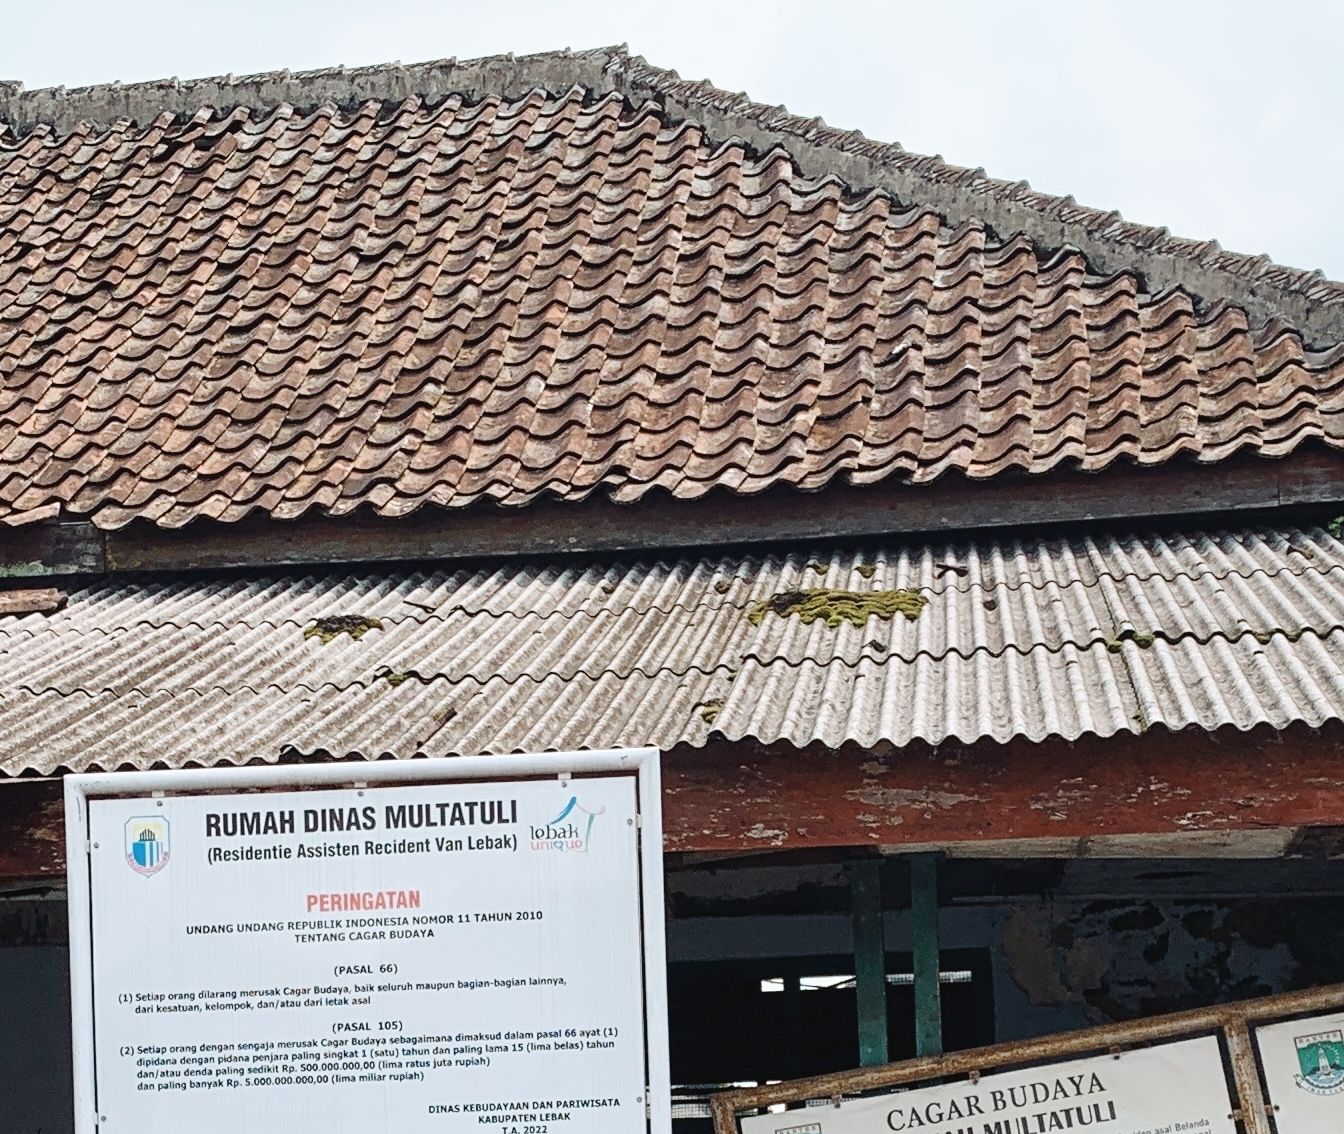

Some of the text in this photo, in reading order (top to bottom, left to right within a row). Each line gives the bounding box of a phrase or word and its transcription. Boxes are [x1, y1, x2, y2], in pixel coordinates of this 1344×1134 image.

[205, 798, 518, 838] RUMAH DINAS MULTATULI
[529, 820, 579, 840] lebak
[206, 833, 518, 866] (Residentie Assisten Recident Van Lebak)
[529, 836, 583, 853] unique
[306, 889, 421, 913] PERINGATAN
[185, 909, 543, 935] UNDANG UNDANG REPUBLIK INDONESIA NOMOR 11 TAHUN 2010
[293, 927, 435, 943] TENTANG CAGAR BUDAYA
[333, 962, 398, 978] (PASAL 66)
[117, 976, 567, 1005] (1) Setiap orang dilarang merusak Cagar Budaya, baik seluruh maupun bagian-bagian lainnya,
[134, 995, 371, 1014] dari kesatuan, kelompok, dan/atau dari letak asal
[331, 1019, 403, 1035] (PASAL 105)
[119, 1026, 619, 1057] (2) Setiap orang dengan sengaja merusak Cagar Budaya sebagaimana dimaksud dalam pasal 66 ayat (1)
[427, 1097, 621, 1114] DINAS KEBUDAYAAN DAN PARIWISATA
[886, 1071, 1107, 1132] CAGAR BUDAYA
[477, 1111, 571, 1124] KABUPATEN LEBAK
[1173, 1117, 1210, 1132] Belanda
[501, 1124, 548, 1134] T.A. 2022
